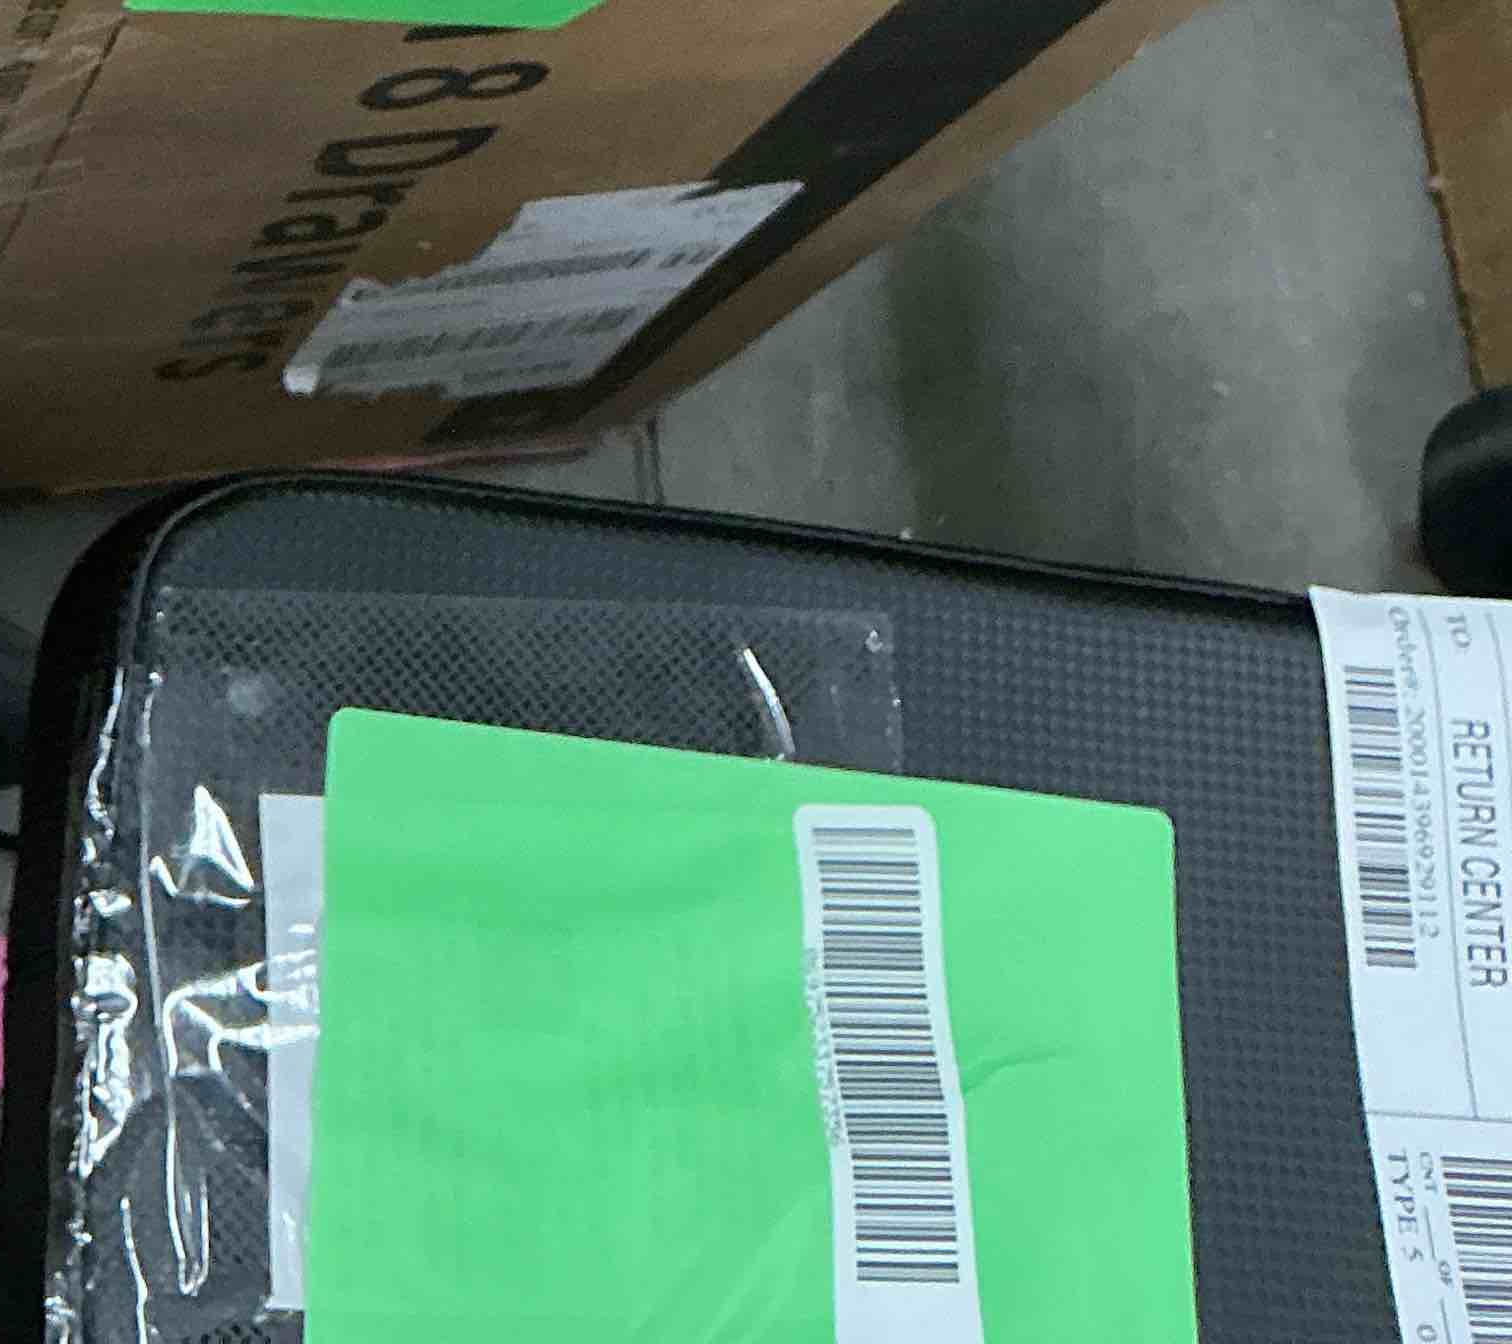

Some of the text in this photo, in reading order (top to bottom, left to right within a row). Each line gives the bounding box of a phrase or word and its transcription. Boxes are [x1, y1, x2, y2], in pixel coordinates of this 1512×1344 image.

[358, 61, 550, 111] 8
[155, 123, 502, 382] Drawers
[1446, 613, 1508, 988] TO RETURN CENTER
[1382, 1151, 1419, 1251] TYPE
